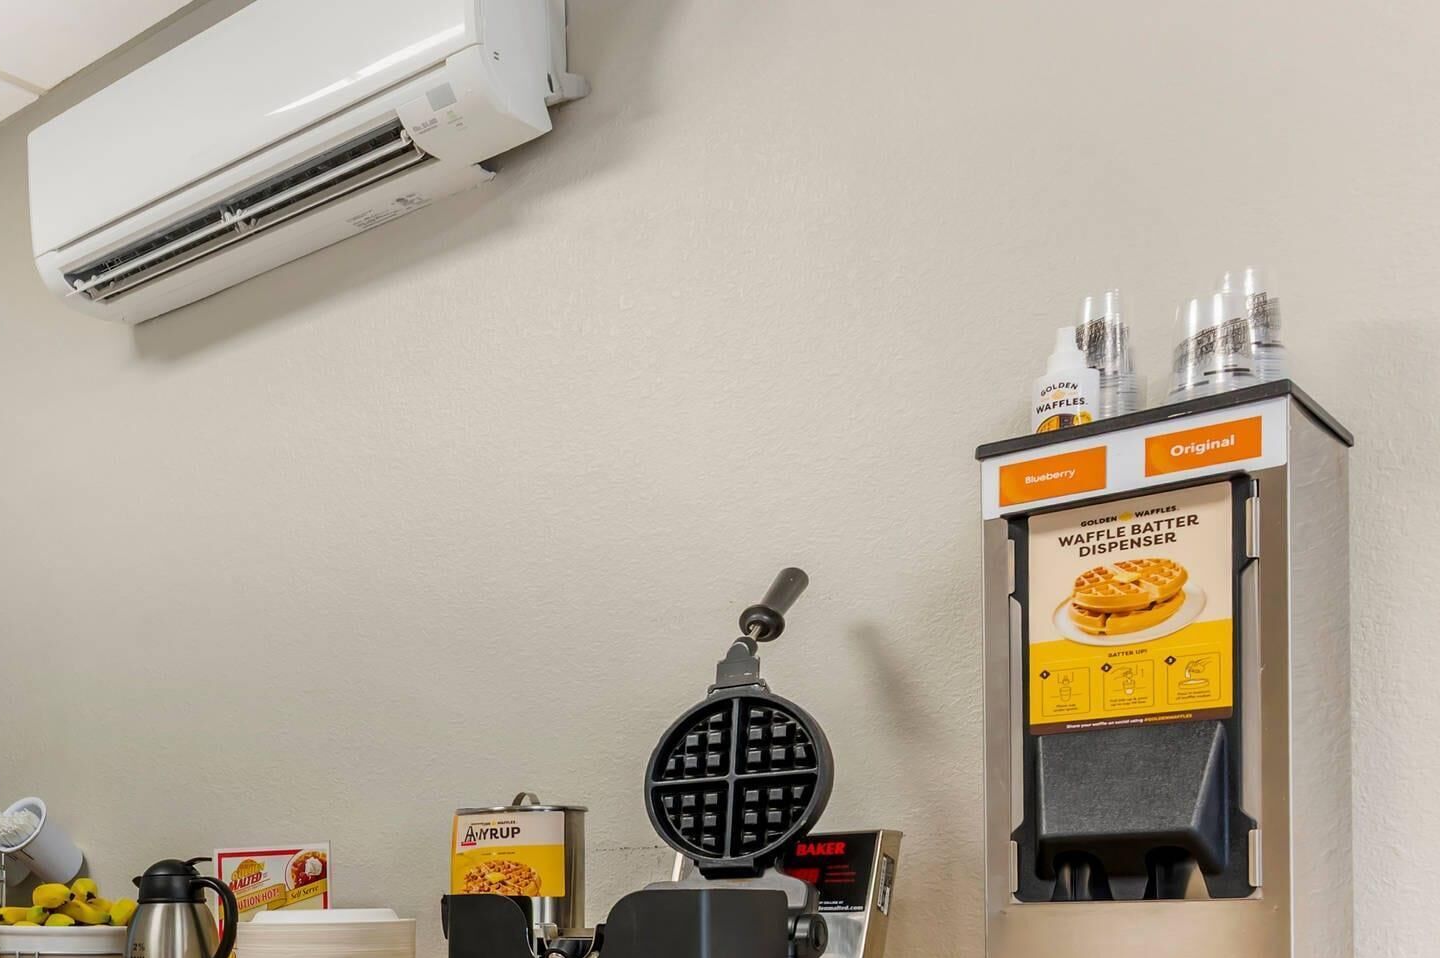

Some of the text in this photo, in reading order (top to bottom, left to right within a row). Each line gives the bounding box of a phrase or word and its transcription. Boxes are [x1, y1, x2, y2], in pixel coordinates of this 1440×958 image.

[1040, 382, 1078, 397] GOLDEN
[1036, 397, 1085, 414] WAFFLES
[1170, 434, 1235, 457] Original
[1025, 468, 1076, 484] Blueberry
[1080, 505, 1176, 527] GOLDEN WAFFLES
[1058, 514, 1199, 547] WAFFLE BATTER
[1079, 531, 1177, 557] DISPENSER
[796, 841, 847, 857] BAKER
[229, 871, 263, 890] MALTED
[238, 894, 261, 910] UTION
[262, 887, 280, 902] HOT!
[133, 943, 145, 952] 2%
